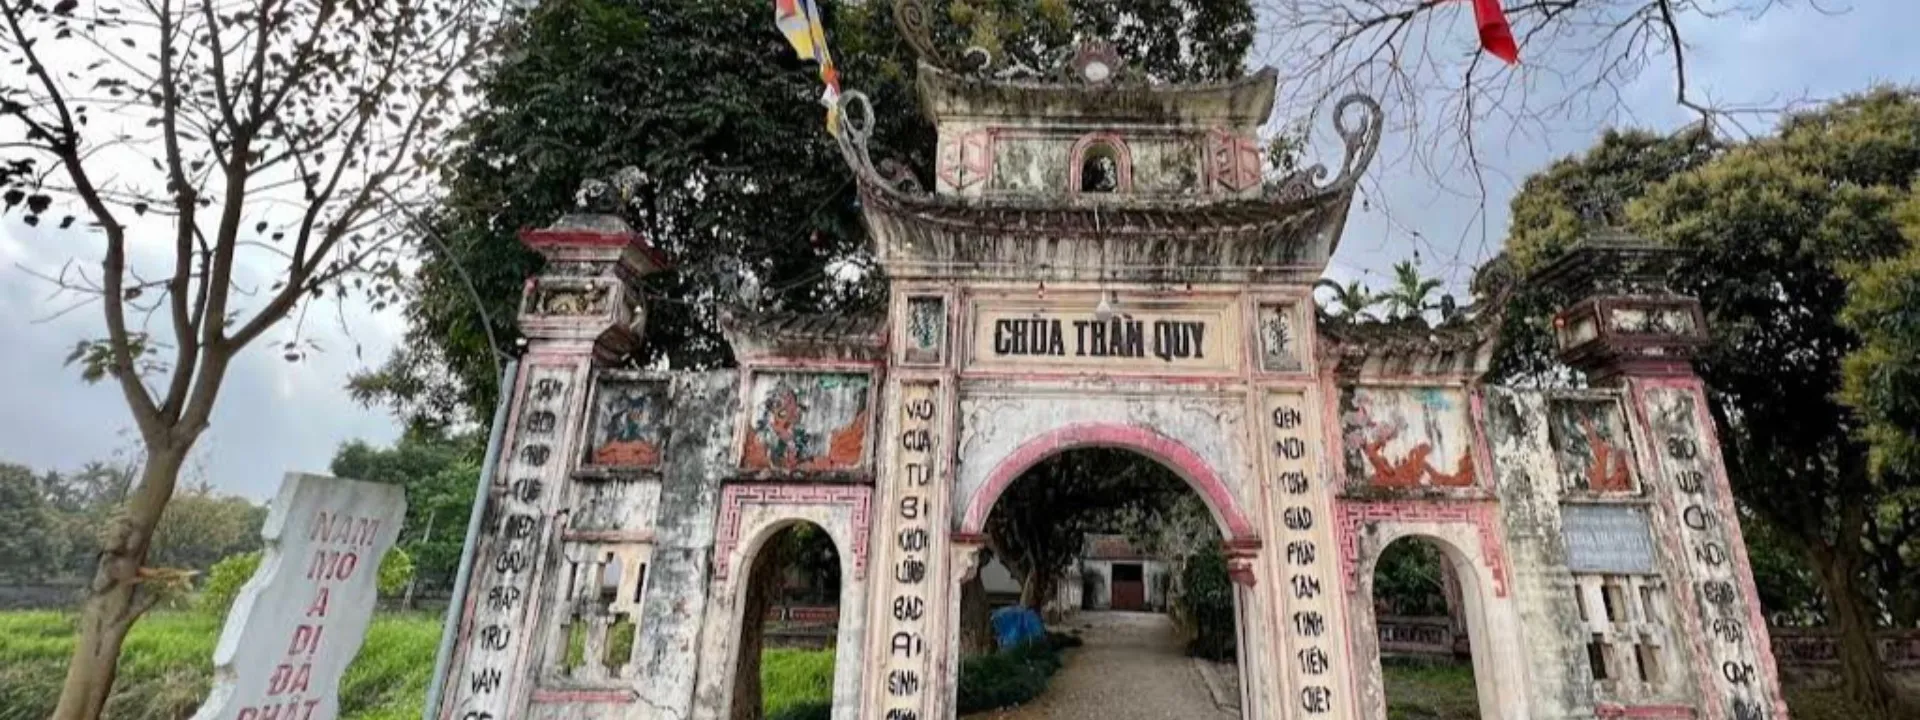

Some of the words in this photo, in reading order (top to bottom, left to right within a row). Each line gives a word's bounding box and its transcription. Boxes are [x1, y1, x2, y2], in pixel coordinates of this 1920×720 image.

[994, 311, 1065, 356] CHÙA
[1154, 319, 1205, 361] QUY
[310, 511, 381, 546] NAM
[306, 587, 330, 618] A
[288, 624, 324, 656] DI
